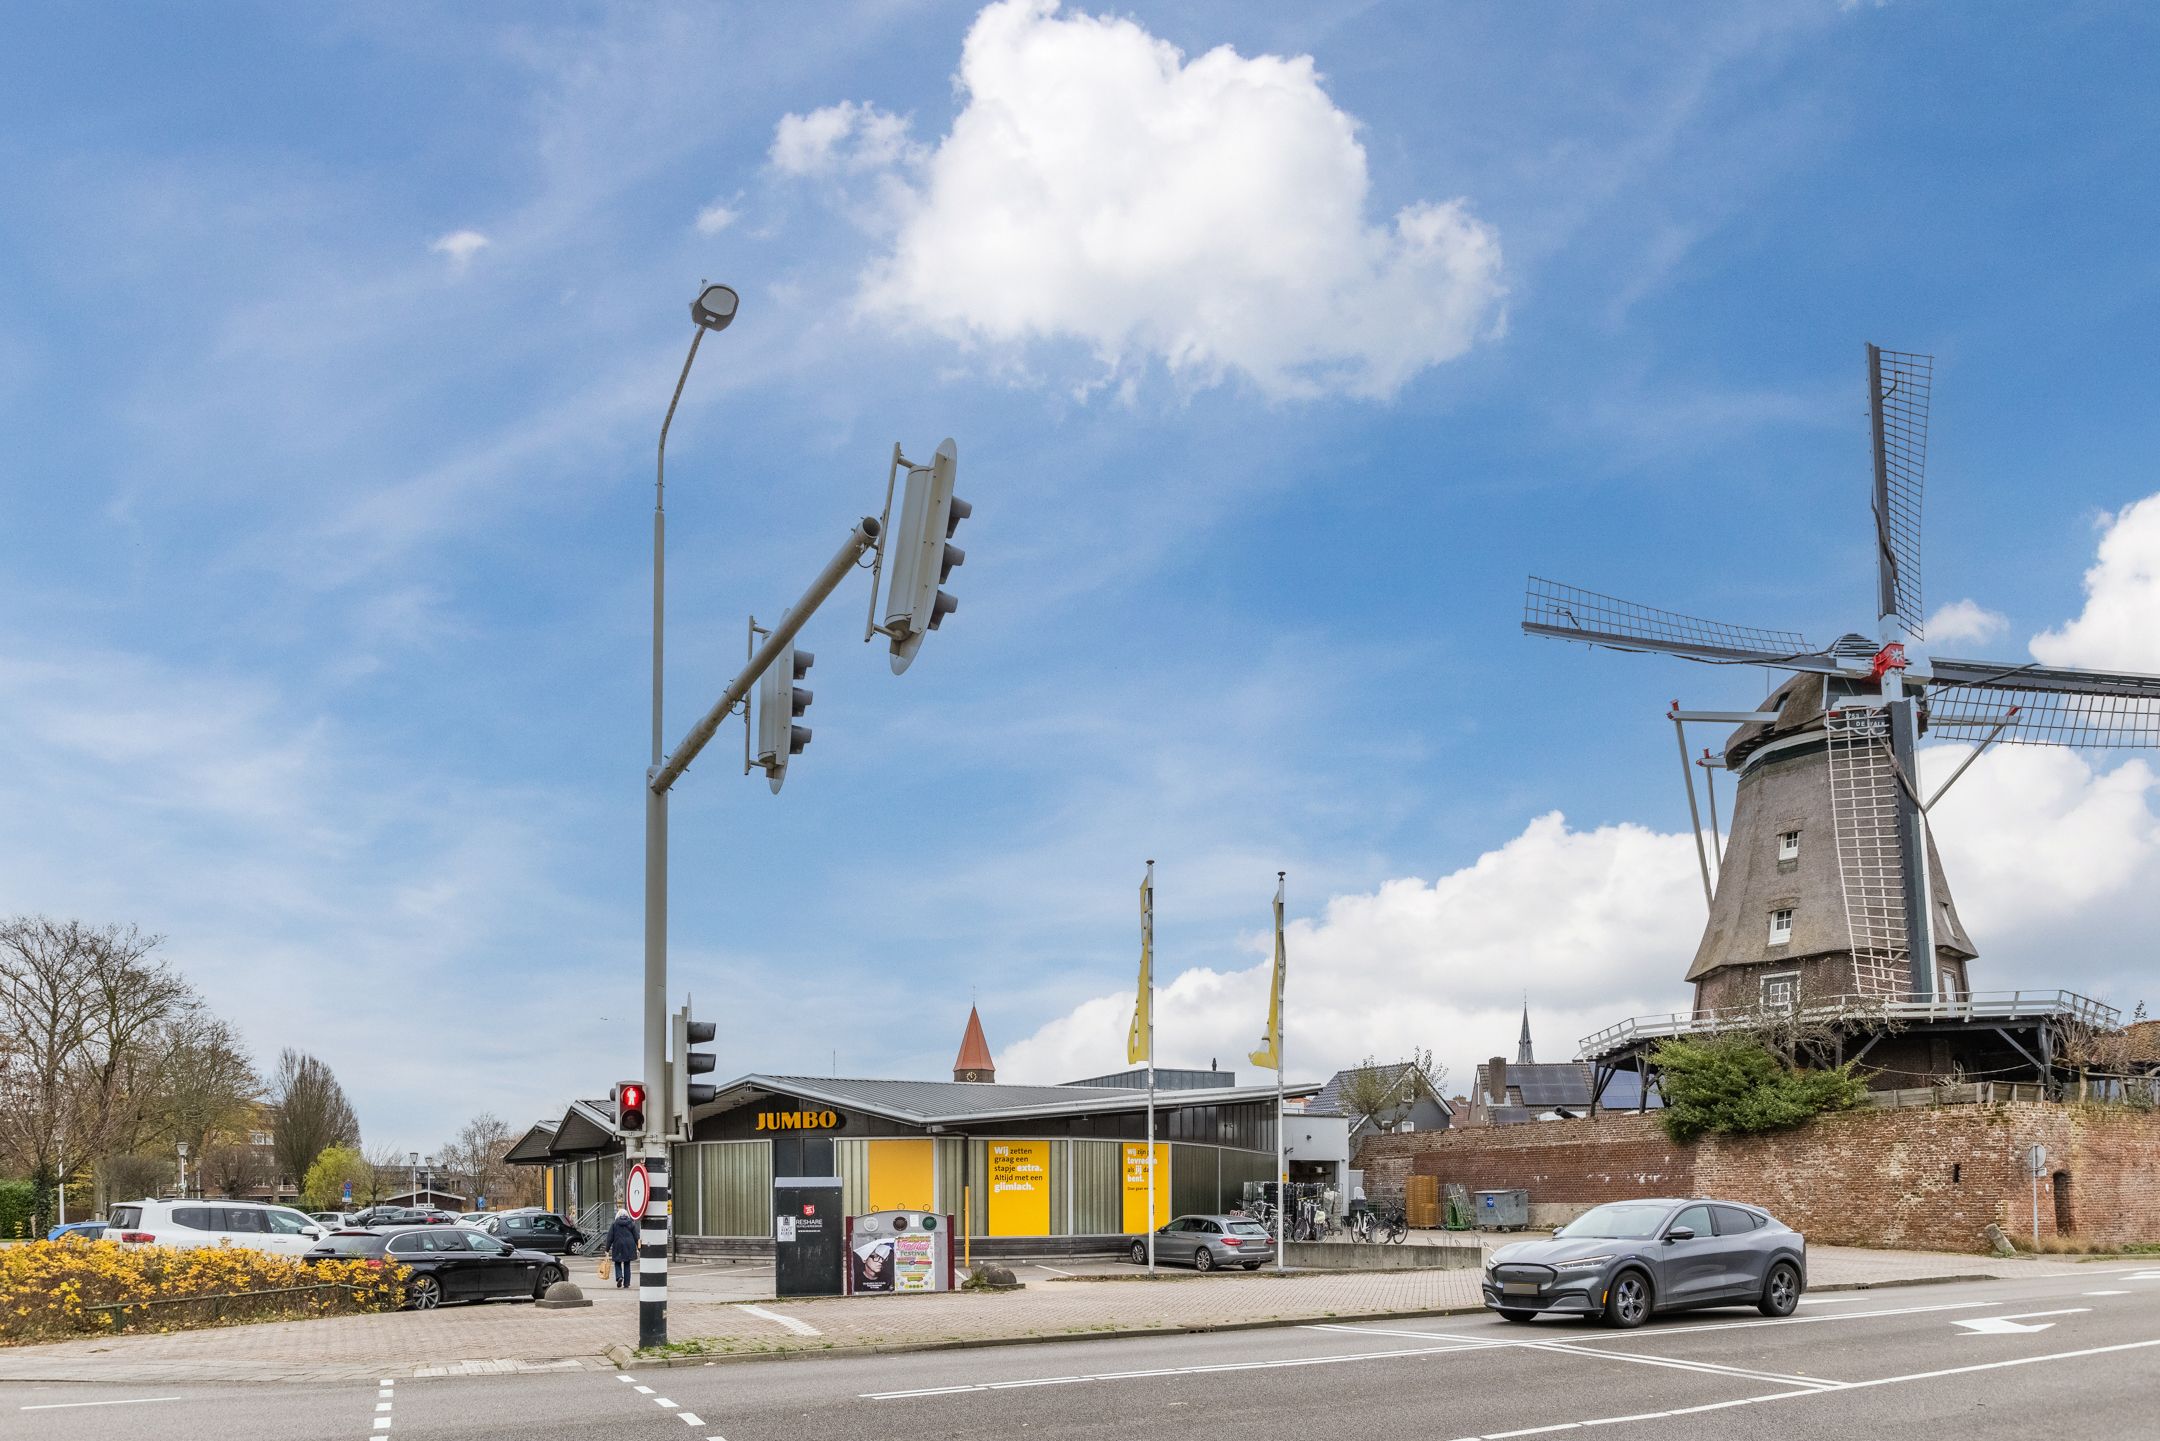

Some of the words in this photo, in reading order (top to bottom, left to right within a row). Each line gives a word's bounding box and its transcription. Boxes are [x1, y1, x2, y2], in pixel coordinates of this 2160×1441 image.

[755, 1110, 837, 1130] JUMBO
[994, 1146, 1009, 1156] Wij
[1127, 1148, 1137, 1156] Wij
[1137, 1148, 1146, 1156] zijn
[1127, 1156, 1158, 1165] tevredn
[994, 1164, 1016, 1173] stapje
[1017, 1164, 1043, 1172] extra.
[1135, 1164, 1143, 1175] jij
[994, 1174, 1014, 1182] Altijd
[1127, 1174, 1145, 1183] bent.
[994, 1182, 1035, 1193] glimlach.
